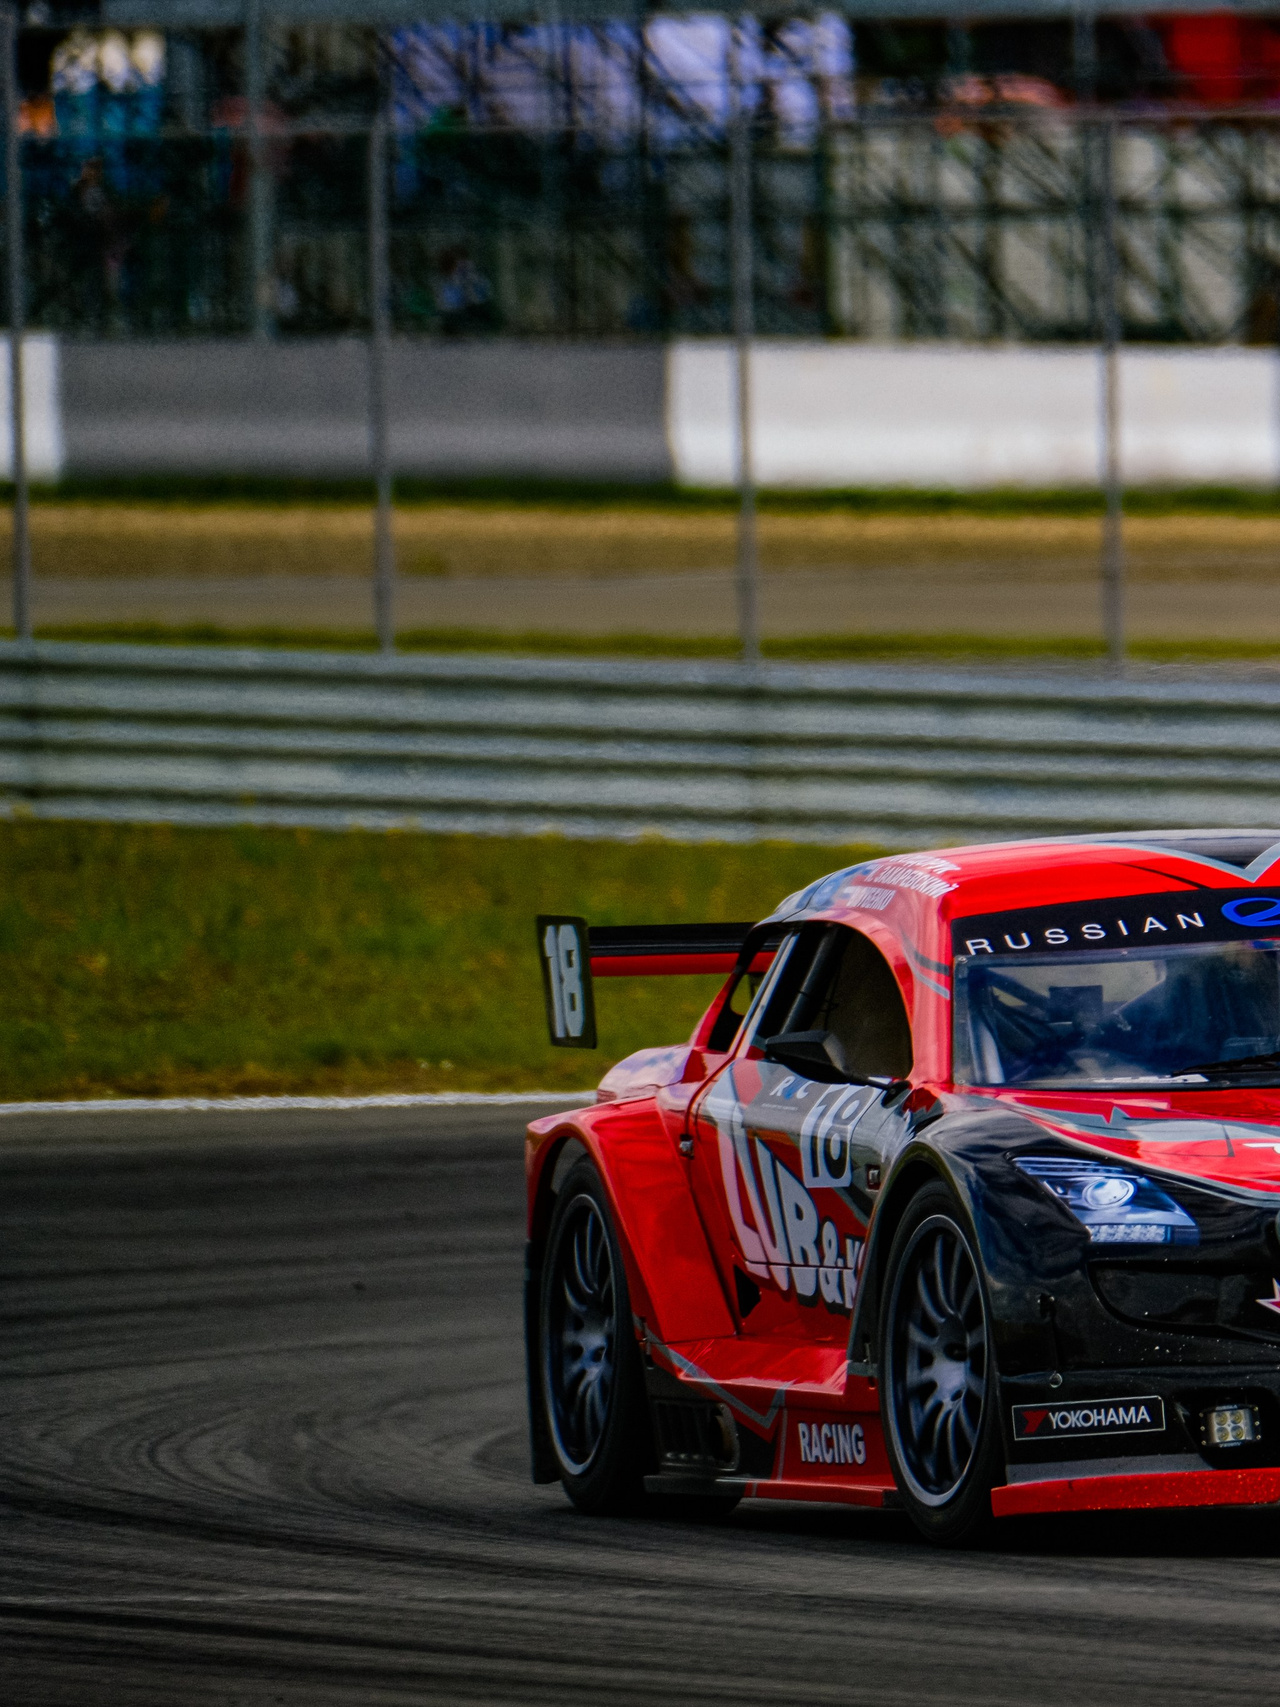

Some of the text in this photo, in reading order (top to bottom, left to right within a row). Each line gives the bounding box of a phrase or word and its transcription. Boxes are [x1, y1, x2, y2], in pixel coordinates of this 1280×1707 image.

[965, 912, 1205, 956] RUSSIAN
[544, 924, 585, 1038] 18
[809, 1084, 876, 1180] 18
[1048, 1405, 1151, 1430] YOKOHAMA
[797, 1422, 867, 1465] RACING
